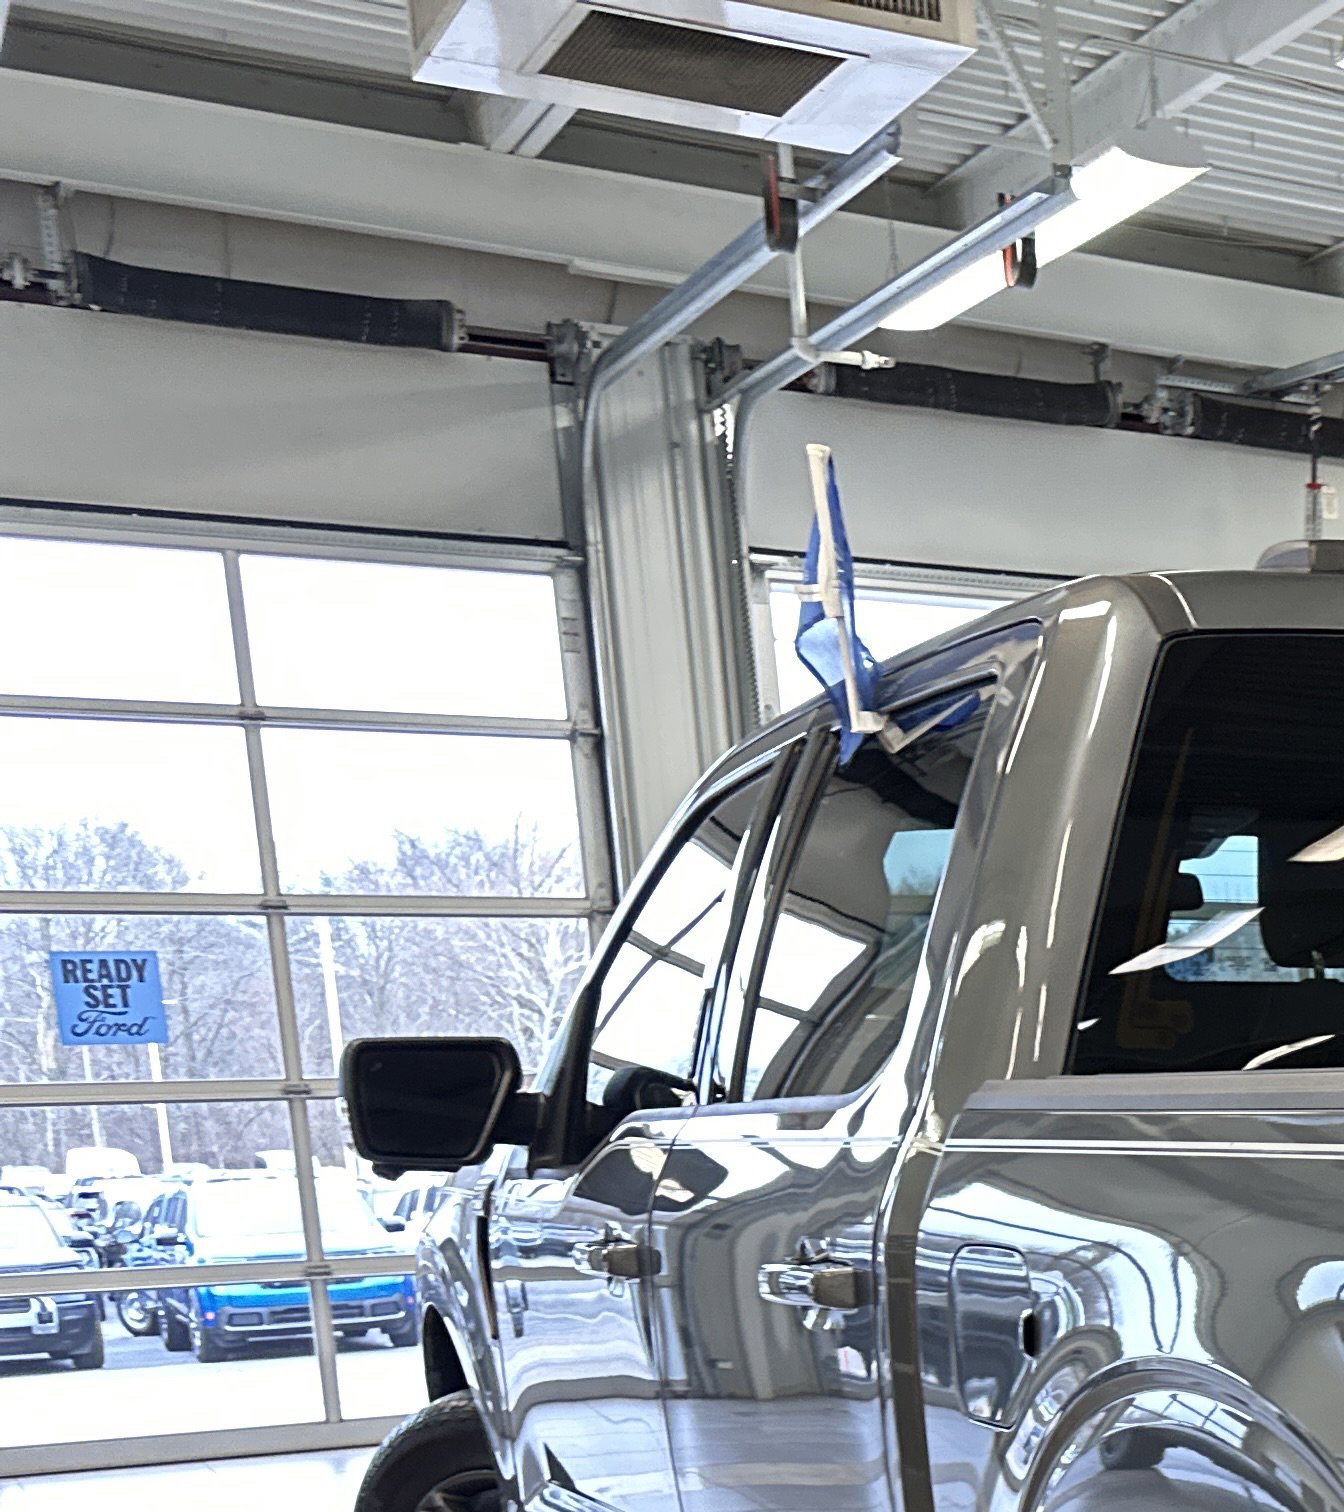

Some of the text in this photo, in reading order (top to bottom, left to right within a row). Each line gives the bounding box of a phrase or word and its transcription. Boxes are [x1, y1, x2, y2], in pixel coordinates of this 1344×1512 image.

[61, 958, 148, 984] READY
[83, 983, 131, 1009] SET
[70, 1009, 157, 1038] Ford
